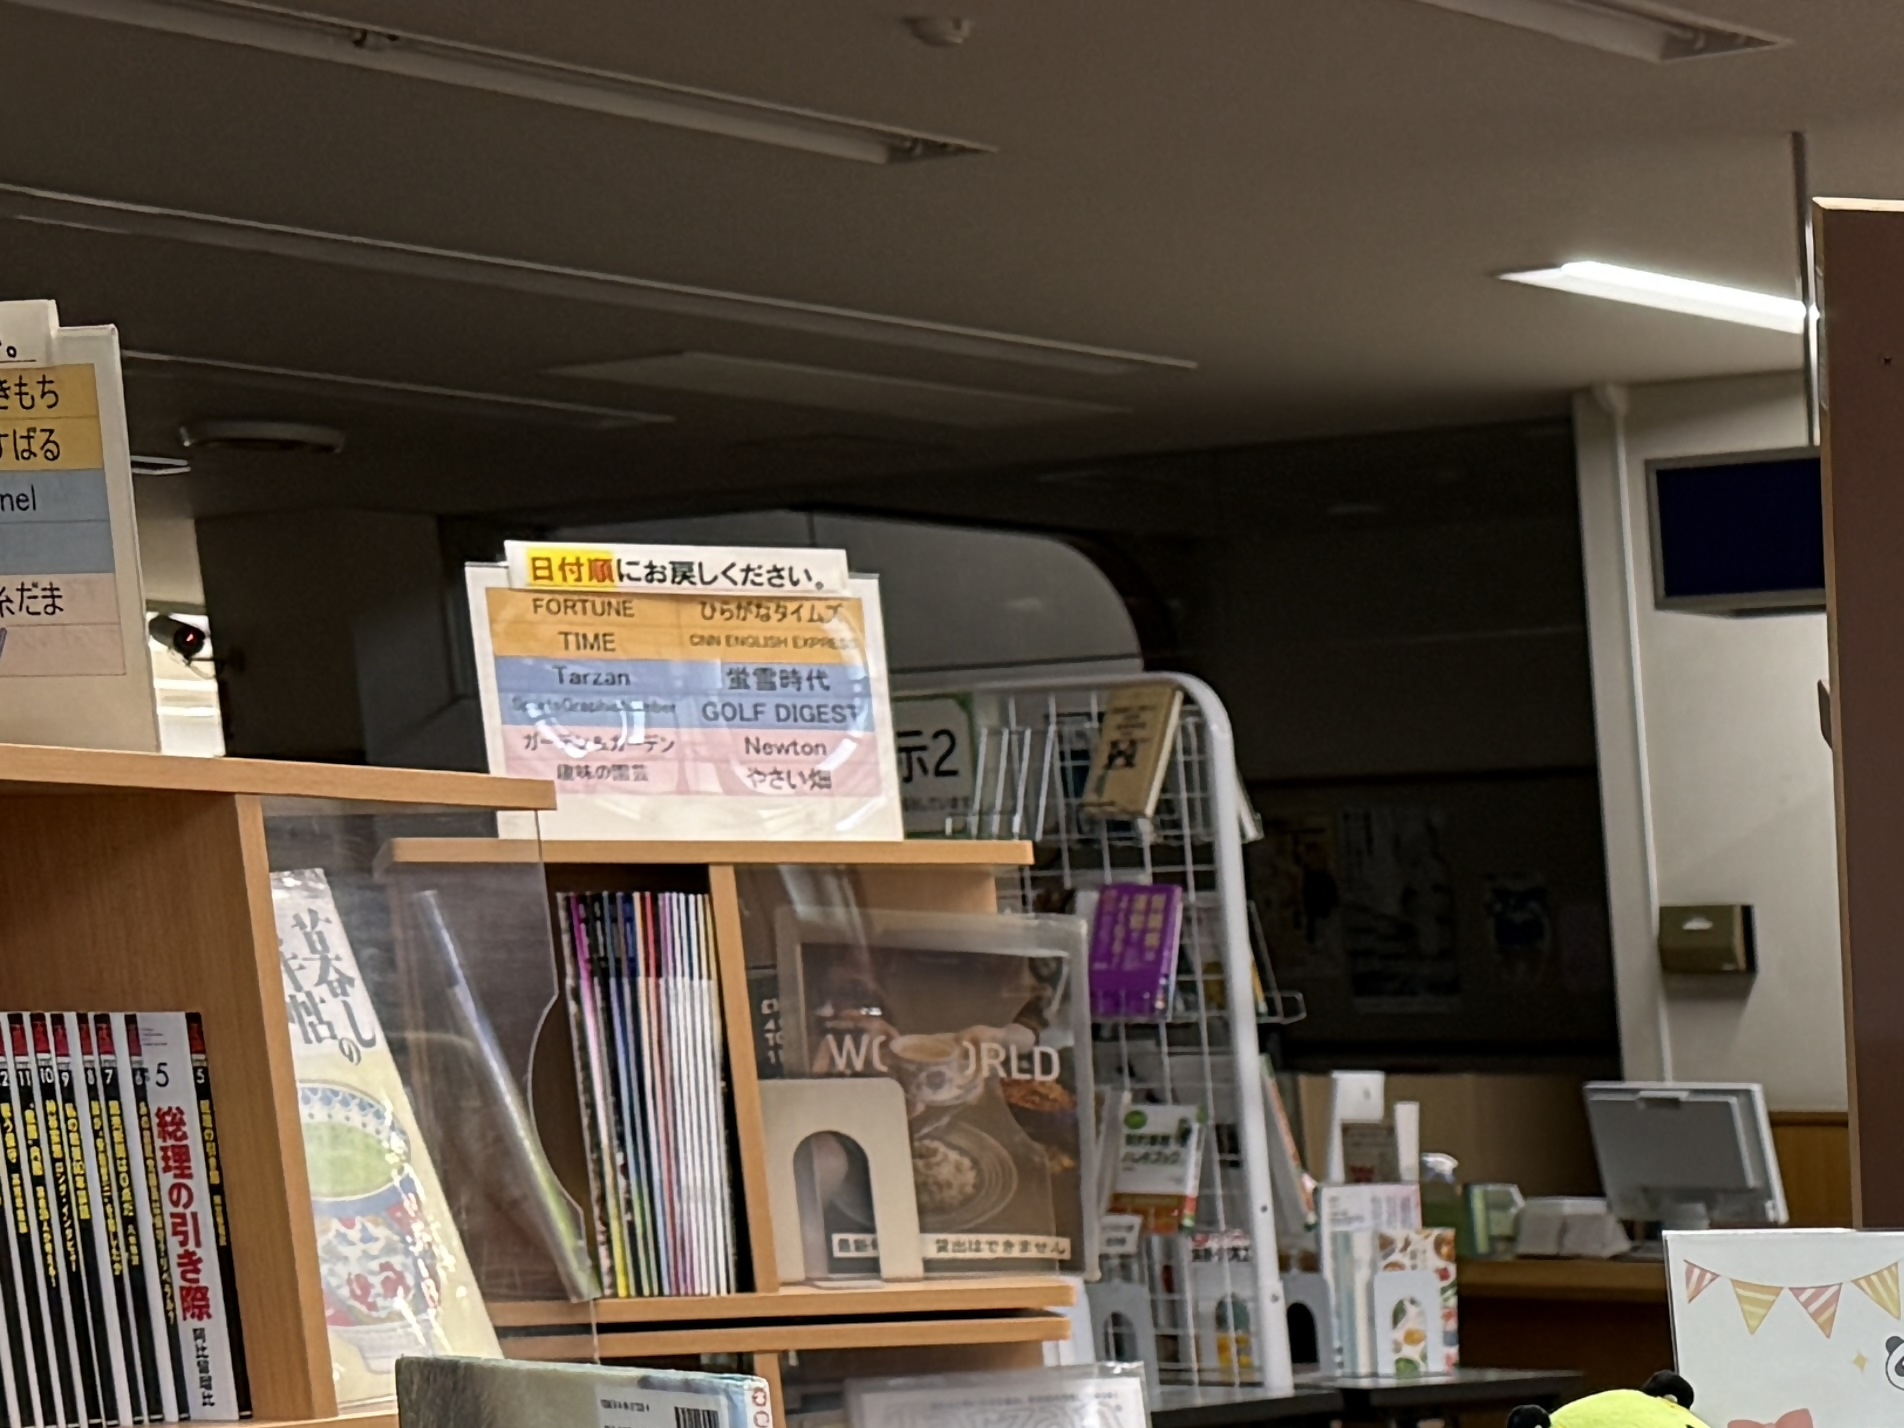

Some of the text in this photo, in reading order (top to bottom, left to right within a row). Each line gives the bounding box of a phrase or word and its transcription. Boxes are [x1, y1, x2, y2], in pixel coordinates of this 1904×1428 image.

[531, 556, 826, 592] 日付順にお戻しください。
[532, 598, 636, 618] FORTUNE
[558, 631, 616, 652] TIME
[552, 666, 631, 687] Tarzan
[701, 702, 859, 725] GOLF DIGEST
[744, 736, 828, 757] Newton
[155, 1062, 170, 1088] 5
[154, 1105, 213, 1322] 総理の引き際
[933, 1239, 1067, 1256] 貸出はできません
